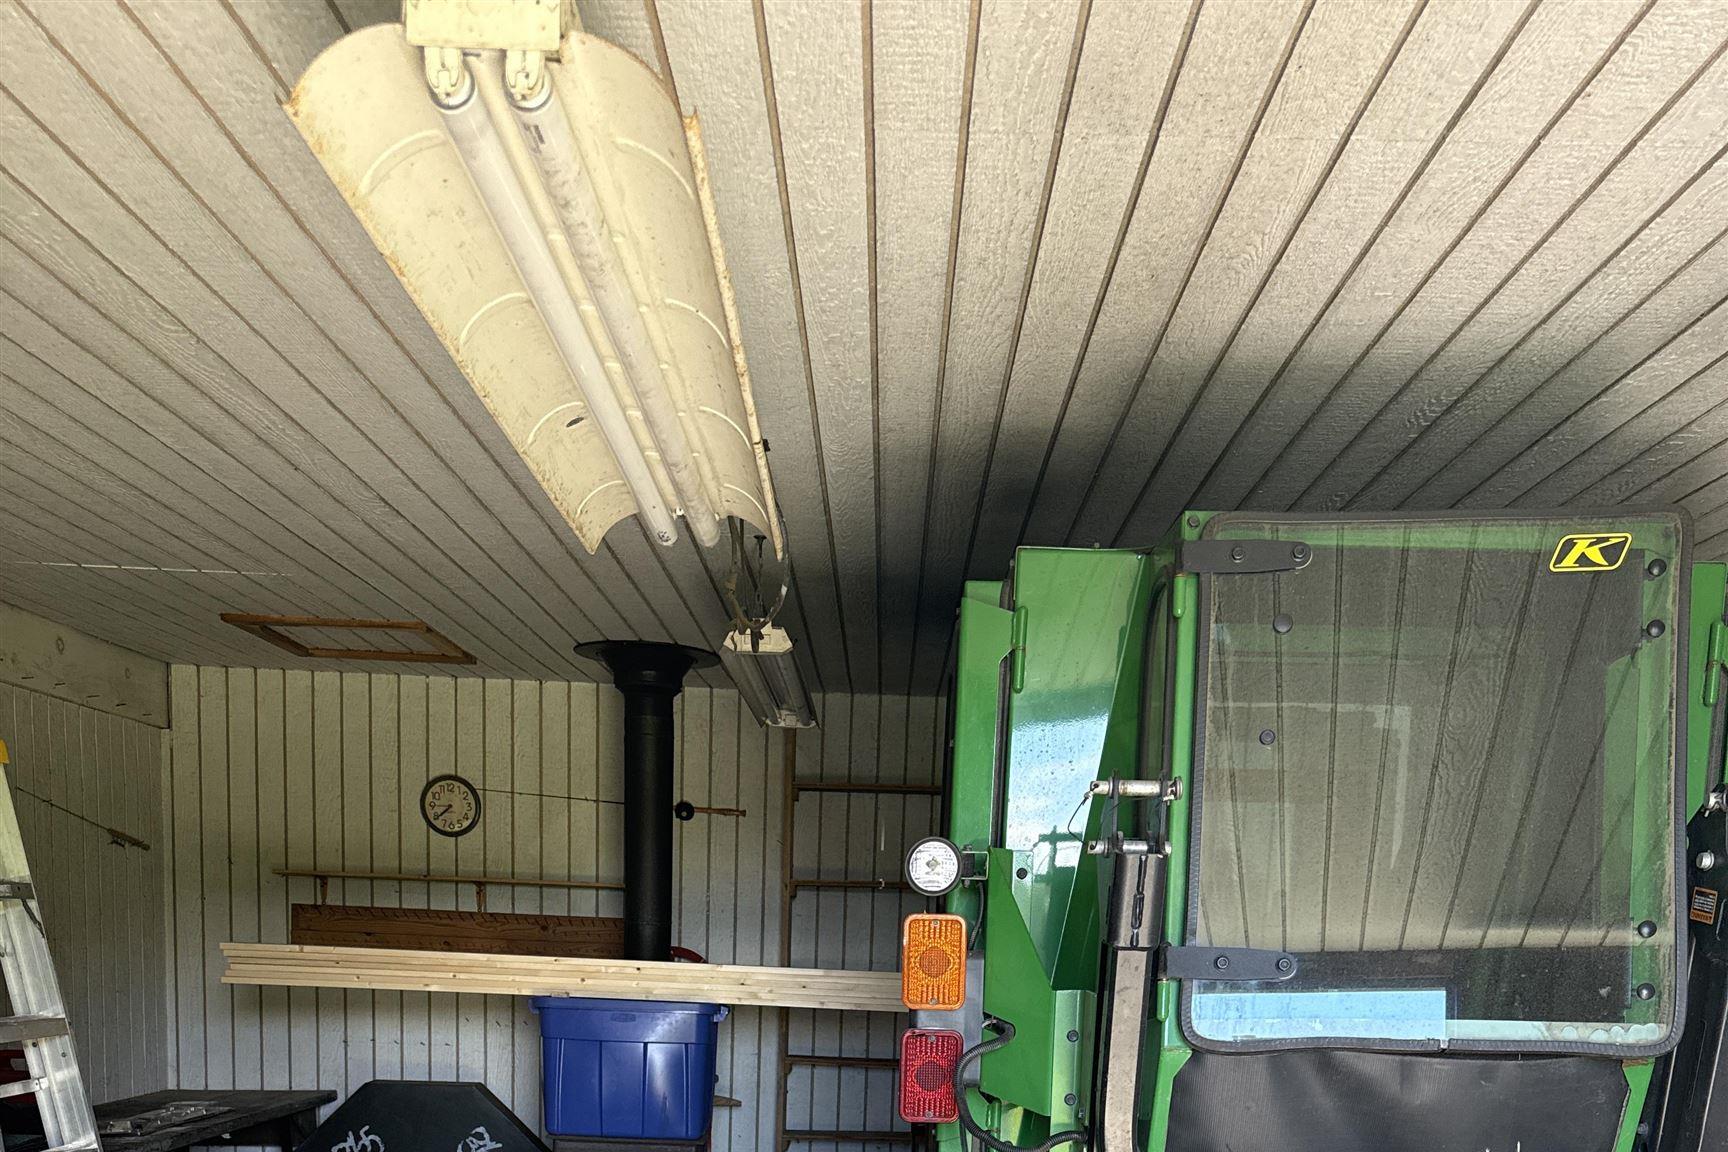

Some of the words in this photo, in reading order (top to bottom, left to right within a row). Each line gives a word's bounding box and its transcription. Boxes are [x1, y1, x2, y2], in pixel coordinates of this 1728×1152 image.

[1555, 538, 1626, 567] K
[439, 785, 445, 794] 11
[446, 783, 455, 793] 12
[457, 786, 461, 795] 1
[431, 791, 440, 801] 10
[463, 791, 469, 800] 2
[429, 801, 436, 810] 9
[466, 802, 472, 812] 3
[433, 812, 439, 820] 8
[463, 813, 469, 821] 4
[441, 819, 447, 828] 7
[448, 821, 455, 830] 6
[457, 820, 463, 829] 5
